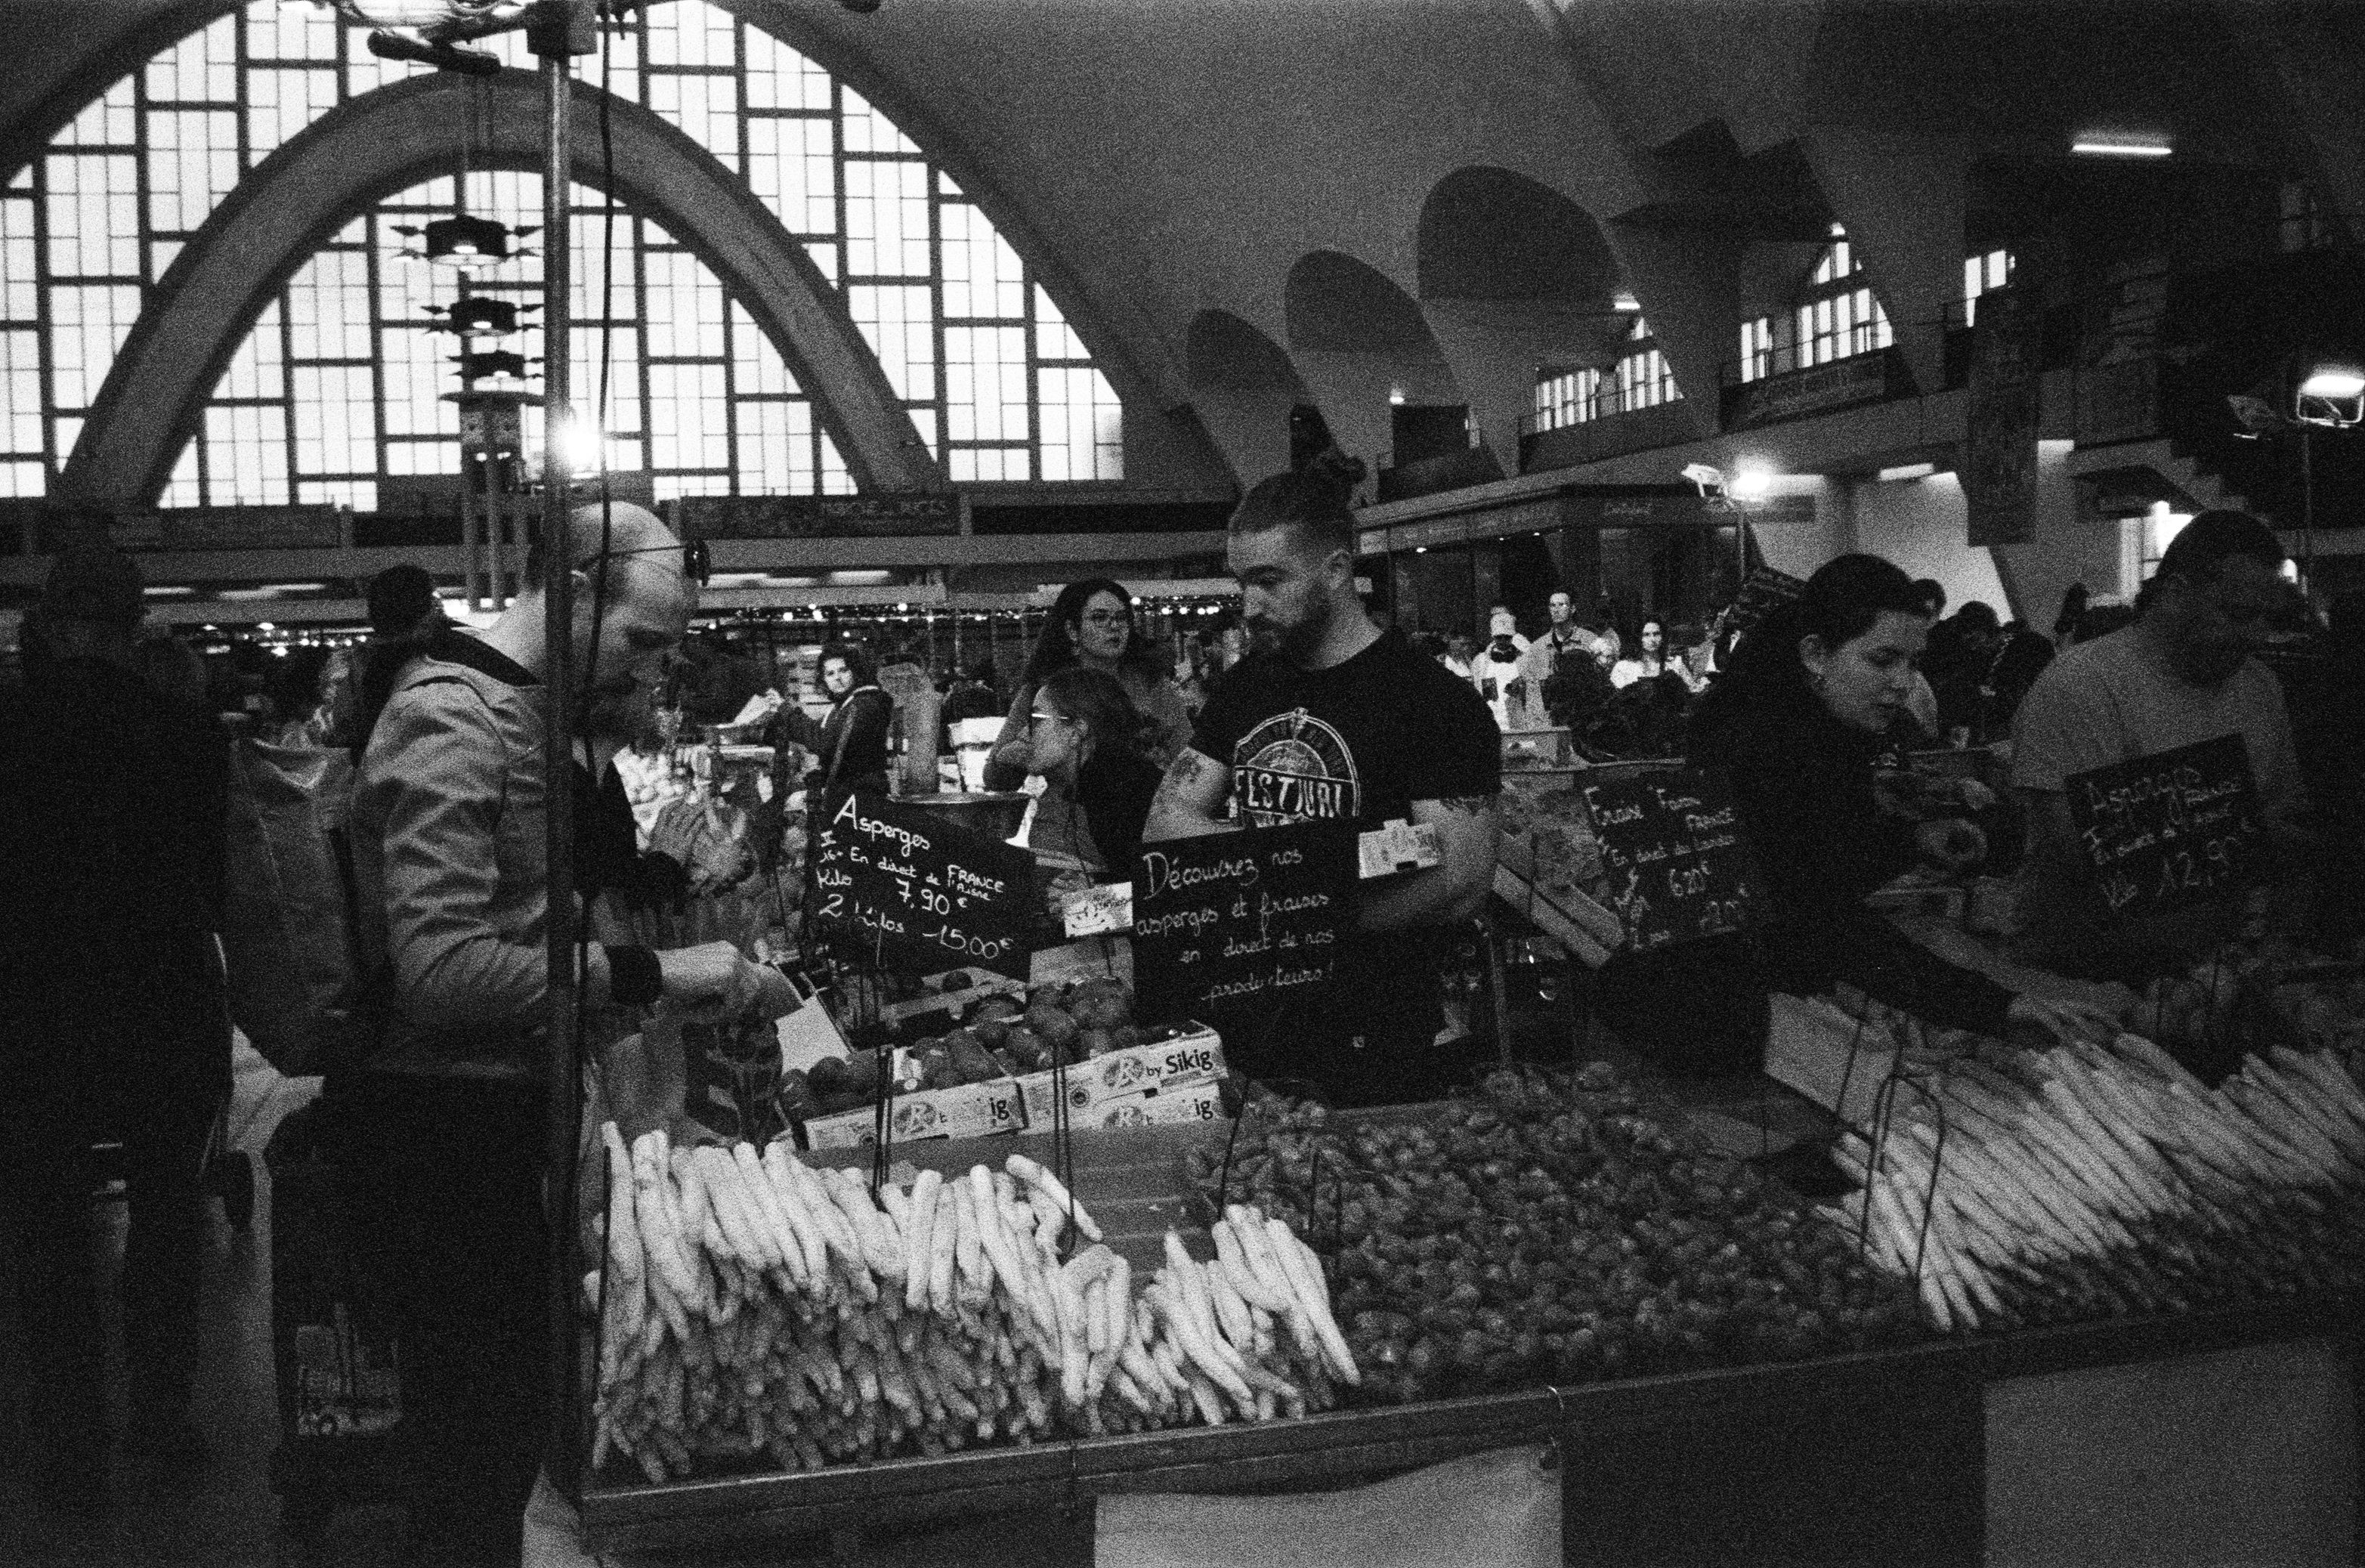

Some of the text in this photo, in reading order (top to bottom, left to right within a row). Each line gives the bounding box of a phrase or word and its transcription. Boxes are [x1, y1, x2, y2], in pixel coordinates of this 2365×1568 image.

[833, 793, 931, 858] Asperges
[815, 869, 852, 889] Kilo
[849, 846, 869, 864] En
[877, 856, 917, 878] direct
[926, 873, 941, 886] de
[947, 864, 1005, 893] FRANCE
[1142, 848, 1303, 900] Découvrez nos
[819, 893, 844, 918] 2
[1136, 892, 1331, 944] asperges et fraises
[1179, 928, 1335, 963] en direct de nos
[1145, 1048, 1213, 1077] by Sikig
